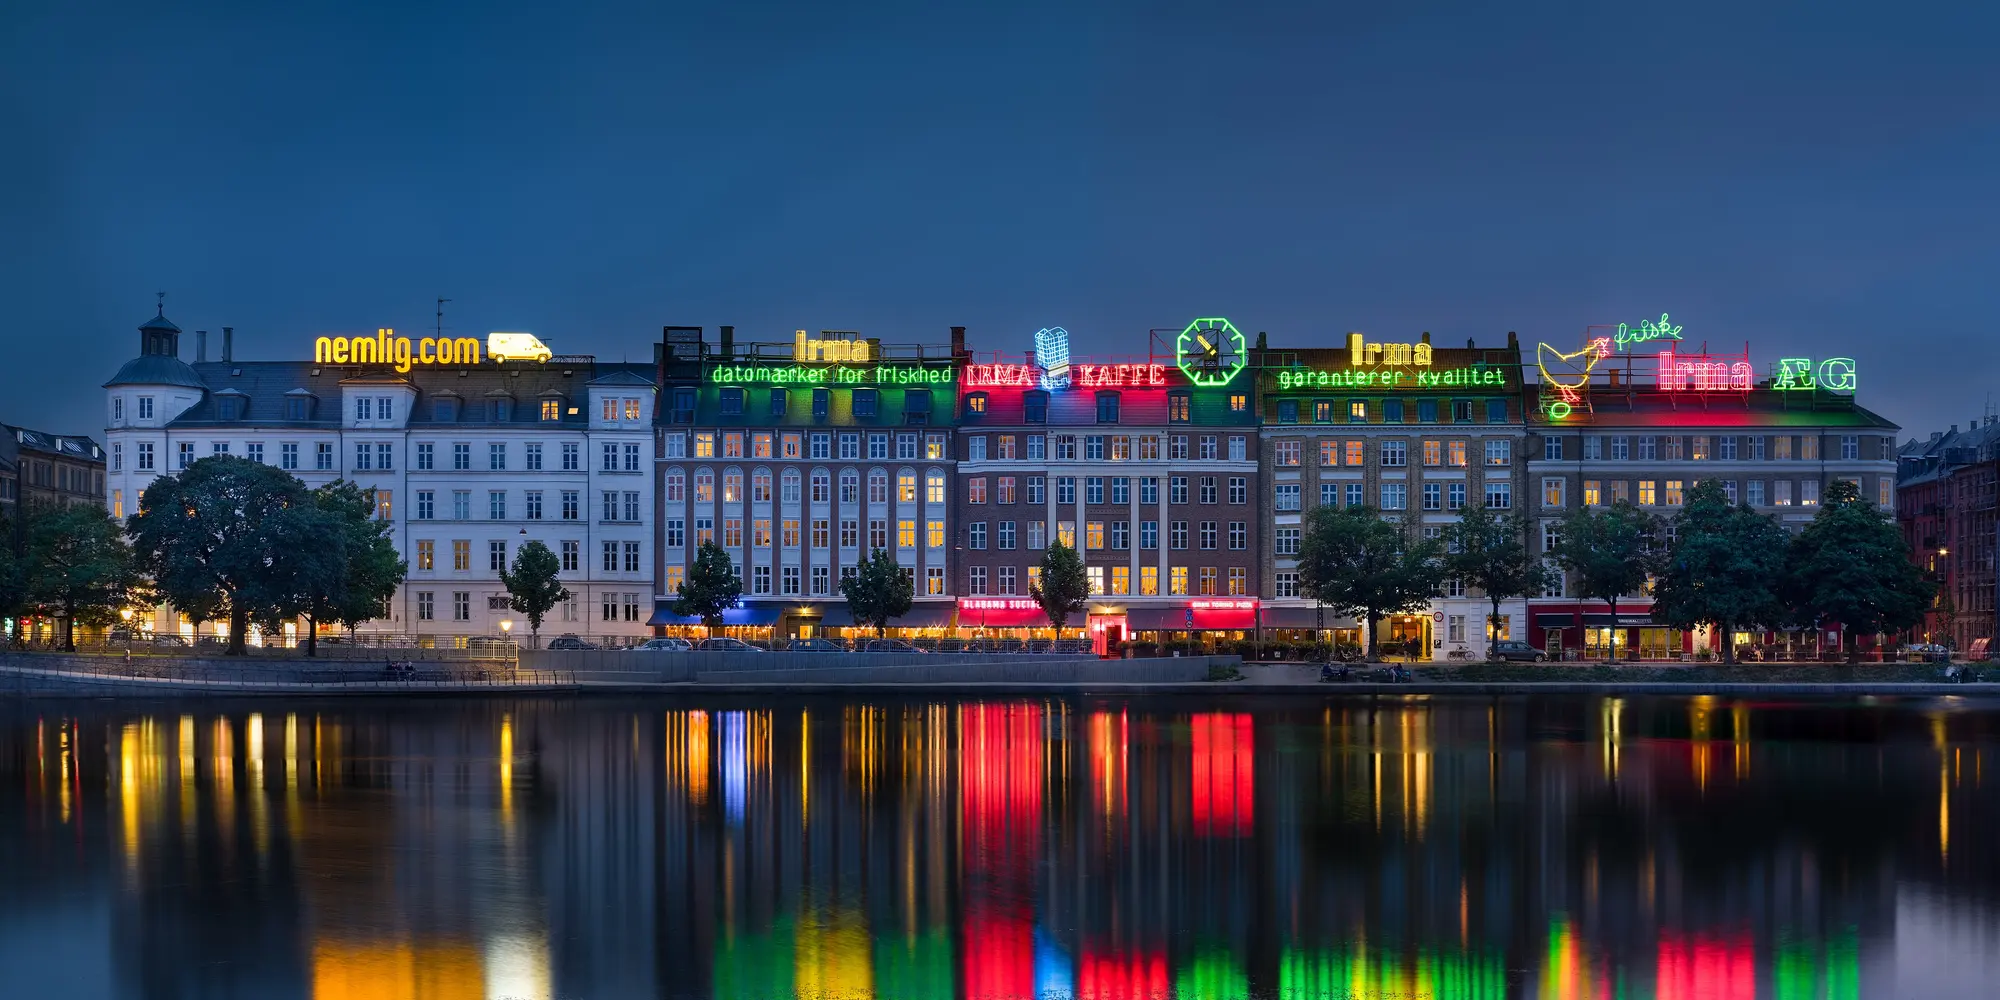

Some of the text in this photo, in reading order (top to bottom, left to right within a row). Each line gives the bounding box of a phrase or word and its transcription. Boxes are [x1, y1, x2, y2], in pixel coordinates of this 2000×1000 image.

[795, 330, 869, 362] Irma
[1614, 313, 1683, 351] friske
[315, 328, 480, 373] nemlig.com
[1352, 333, 1432, 366] Irma
[713, 364, 952, 383] datomærker for friskhed
[966, 364, 1165, 386] IRMA KAFFE
[1279, 367, 1506, 389] garanterer kvalitet
[1660, 351, 1753, 391] Irma
[1774, 357, 1856, 390] ÆG
[963, 600, 1006, 609] ALABAMA
